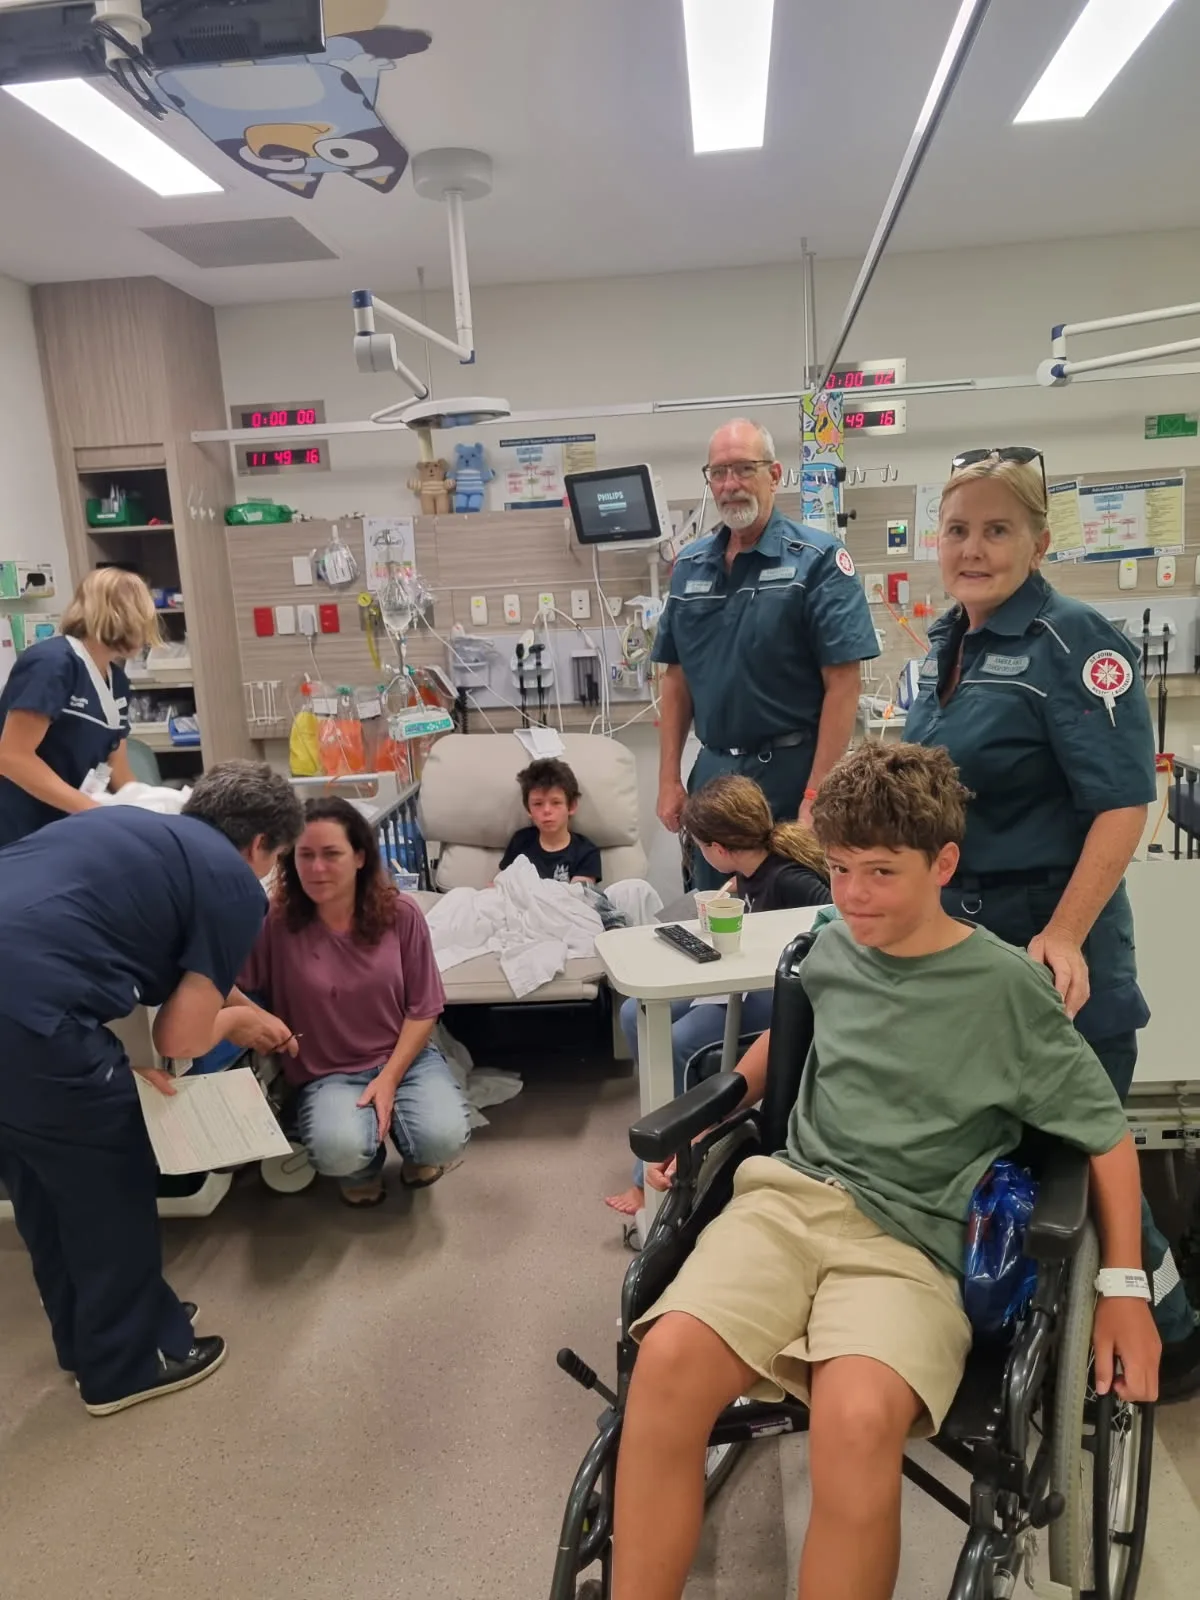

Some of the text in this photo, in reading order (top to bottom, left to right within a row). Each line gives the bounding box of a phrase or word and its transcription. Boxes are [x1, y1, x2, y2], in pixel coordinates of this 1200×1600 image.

[874, 368, 894, 385] 02
[252, 409, 315, 428] 0:00 00
[845, 410, 894, 428] 49 16
[253, 448, 319, 466] 11 49 16
[597, 491, 624, 502] PHILIPS
